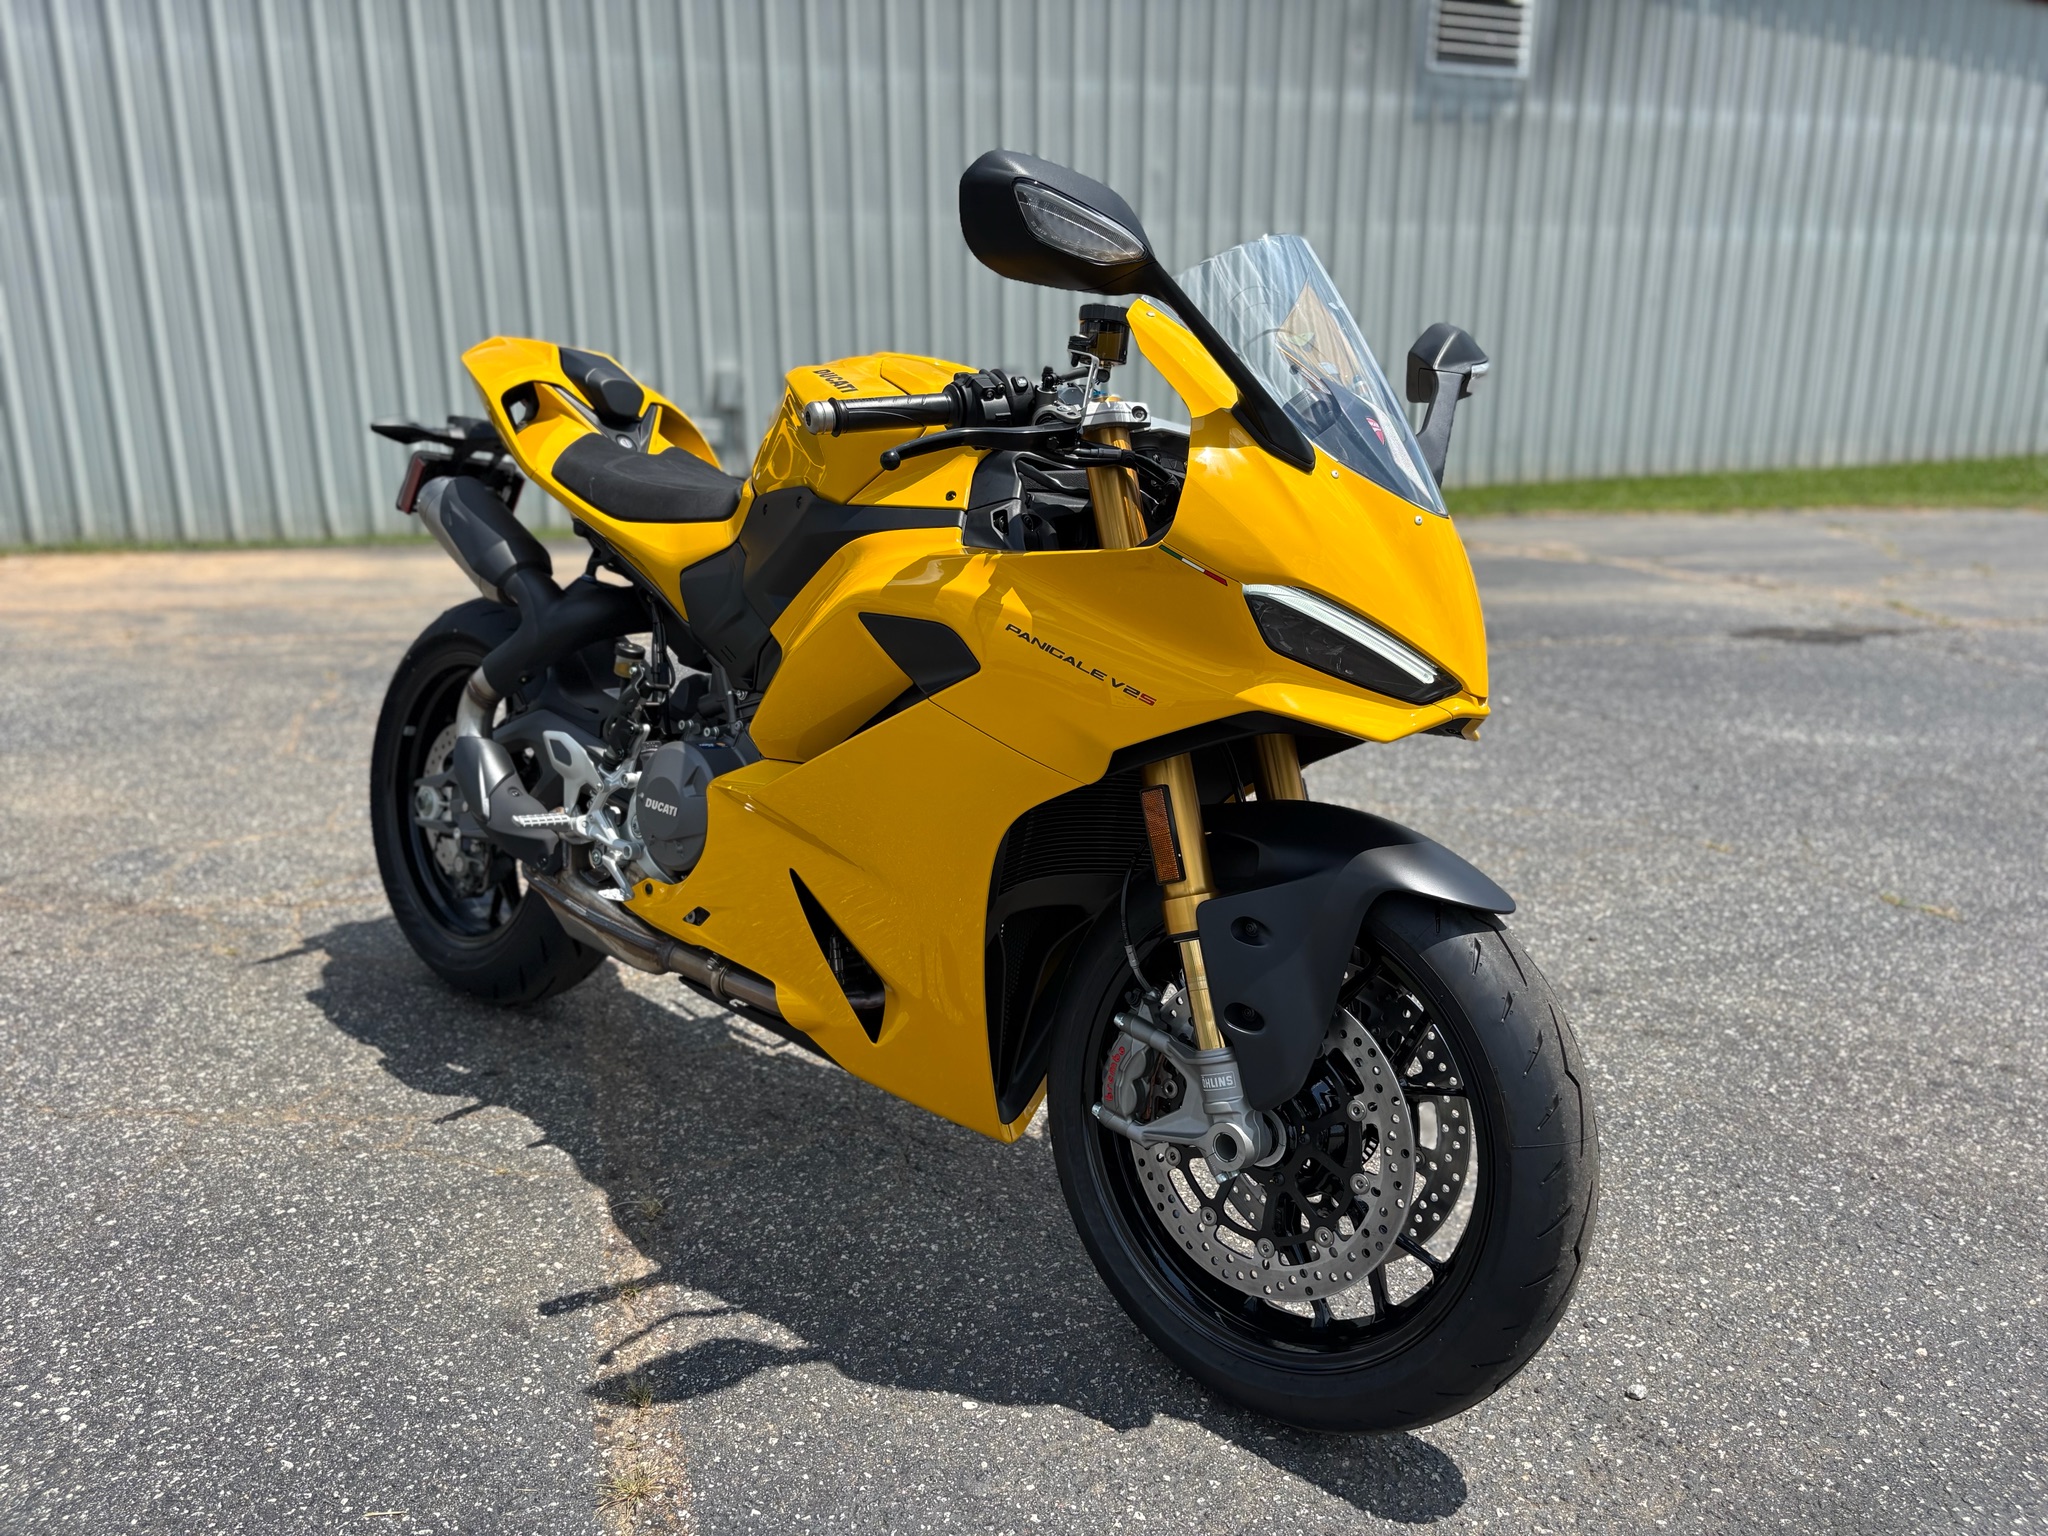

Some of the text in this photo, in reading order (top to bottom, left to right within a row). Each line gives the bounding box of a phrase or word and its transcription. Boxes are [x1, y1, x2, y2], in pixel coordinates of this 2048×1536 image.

[812, 369, 859, 393] DUCATI
[1005, 623, 1157, 707] PANIGALE V2S
[645, 798, 678, 817] DUCATI
[1104, 1046, 1125, 1101] brembo
